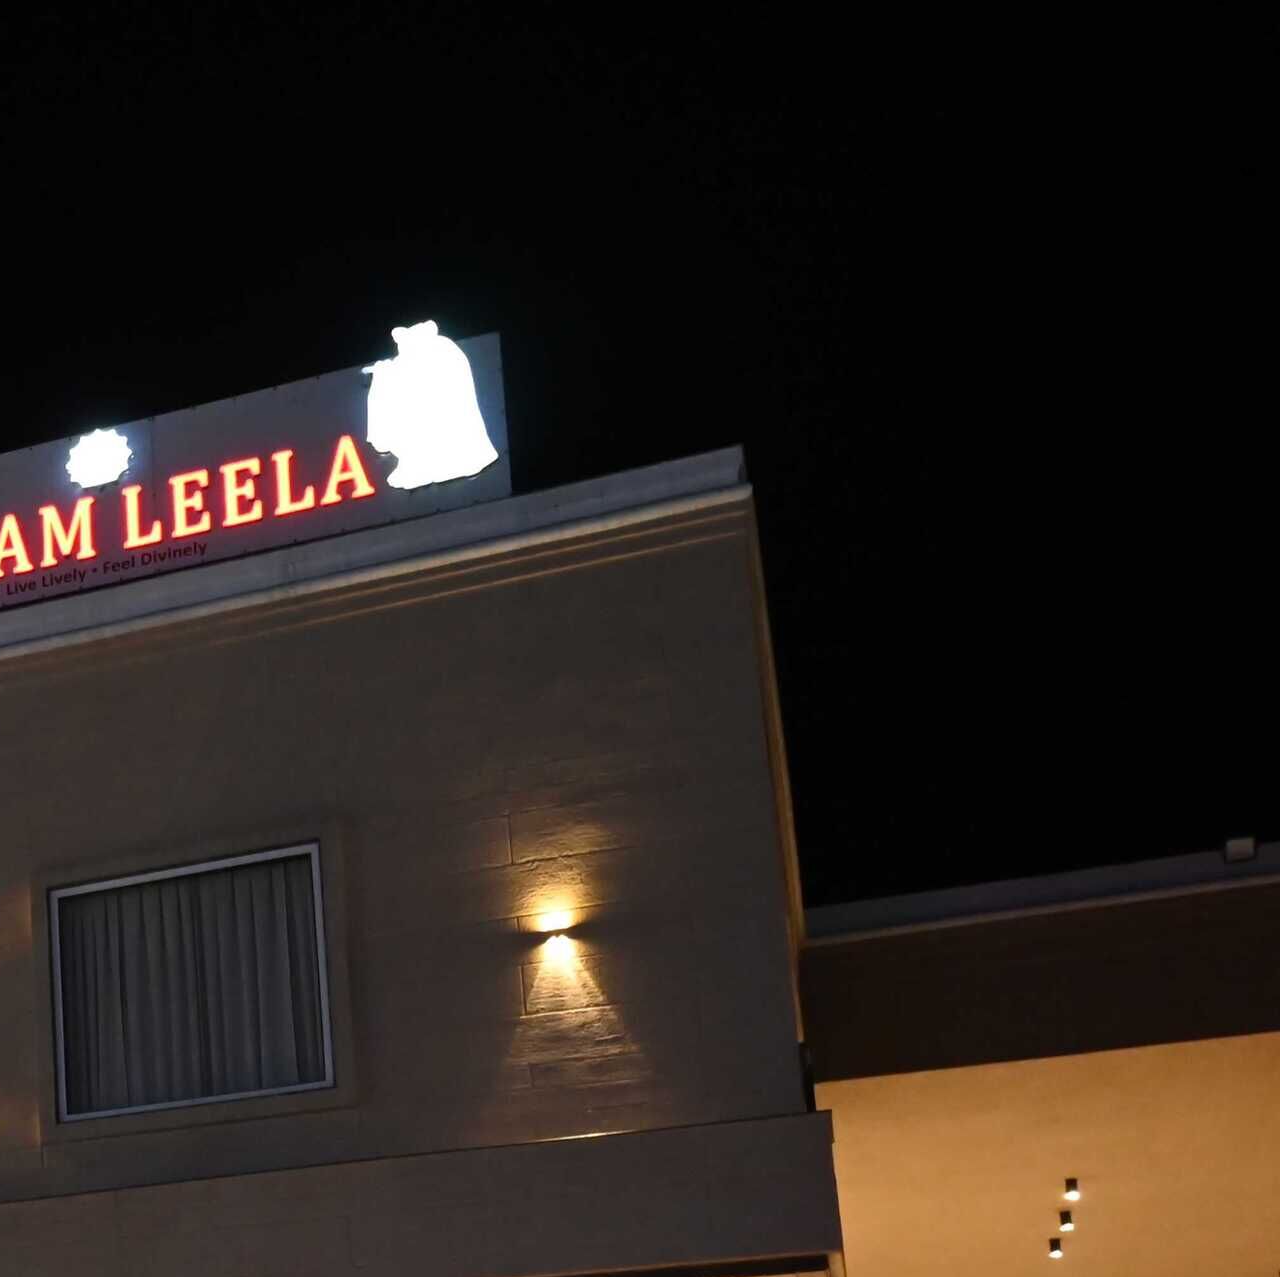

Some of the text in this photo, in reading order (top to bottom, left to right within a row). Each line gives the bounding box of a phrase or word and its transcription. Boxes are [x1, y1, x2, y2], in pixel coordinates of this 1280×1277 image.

[123, 434, 375, 550] LEELA
[6, 541, 208, 596] Live Lively Feel Divinely
